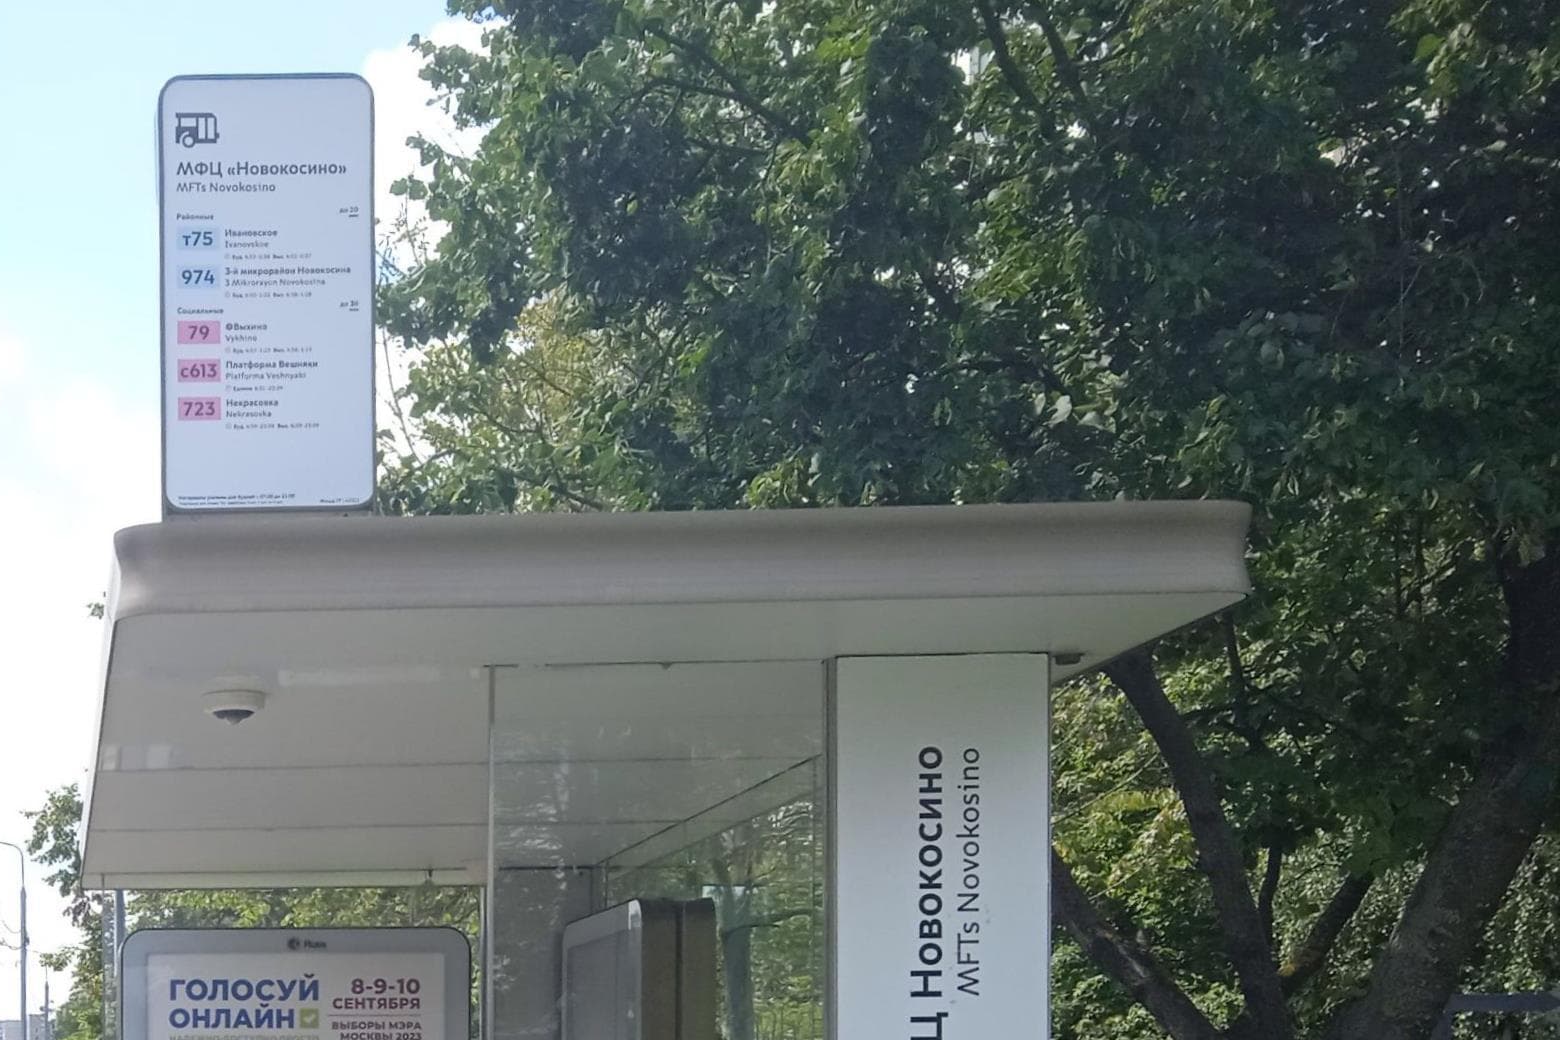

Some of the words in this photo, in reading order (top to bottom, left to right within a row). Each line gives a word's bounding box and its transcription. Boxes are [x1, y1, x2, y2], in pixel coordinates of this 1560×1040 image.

[176, 161, 223, 178] МФЦ
[227, 161, 347, 176] «Новокосино»
[176, 182, 206, 192] MFTs
[209, 182, 276, 192] Novokosino
[225, 229, 278, 238] Ивановское
[182, 270, 215, 285] 974
[240, 267, 295, 277] микрорайон
[297, 266, 351, 275] Новокосина
[177, 307, 224, 315] Социальные
[188, 325, 210, 340] 79
[233, 323, 267, 331] Выхино
[225, 334, 258, 343] Vykhino
[180, 363, 217, 378] с613
[226, 360, 277, 370] Платформа
[279, 360, 318, 368] Вешняки
[183, 401, 215, 416] 723
[226, 399, 279, 408] Некрасовка
[226, 410, 272, 418] Nekrasovka
[956, 748, 980, 912] Novokosino
[910, 746, 943, 997] Новокосино
[957, 922, 980, 996] MFTs
[170, 973, 319, 1001] ГОЛОСУЙ
[351, 978, 421, 995] 8-9-10
[332, 998, 421, 1010] СЕНТЯБРЯ
[169, 1003, 294, 1029] ОНЛАЙН
[332, 1021, 385, 1030] ВЫБОРЫ
[389, 1021, 422, 1030] МЭРА
[340, 1032, 393, 1040] МОСКВЫ
[396, 1032, 422, 1040] 2023
